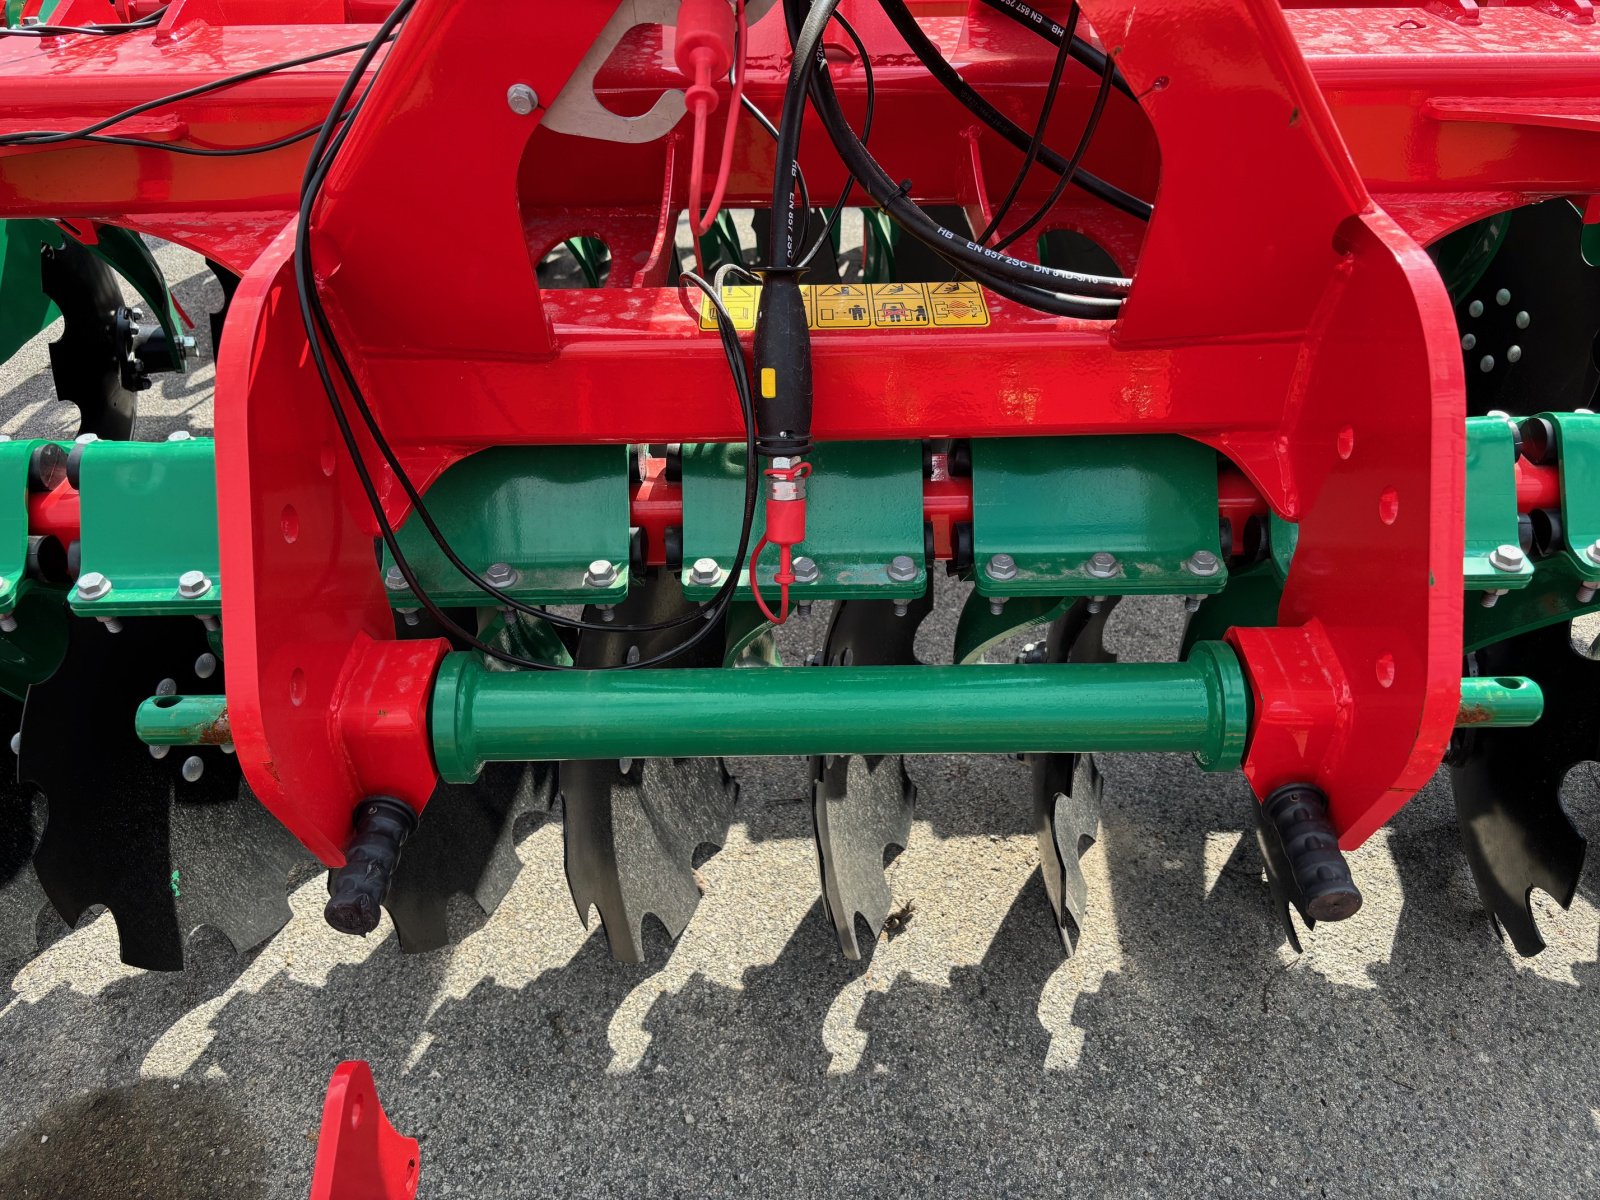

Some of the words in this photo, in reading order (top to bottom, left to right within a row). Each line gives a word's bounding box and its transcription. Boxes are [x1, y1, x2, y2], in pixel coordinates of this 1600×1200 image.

[1016, 3, 1031, 16] 857
[1030, 10, 1043, 23] EN
[1051, 24, 1065, 37] HB
[937, 226, 954, 240] HB
[966, 241, 983, 253] EN
[984, 248, 1003, 261] 857
[1005, 256, 1028, 269] 2SC
[1033, 264, 1050, 275] DN
